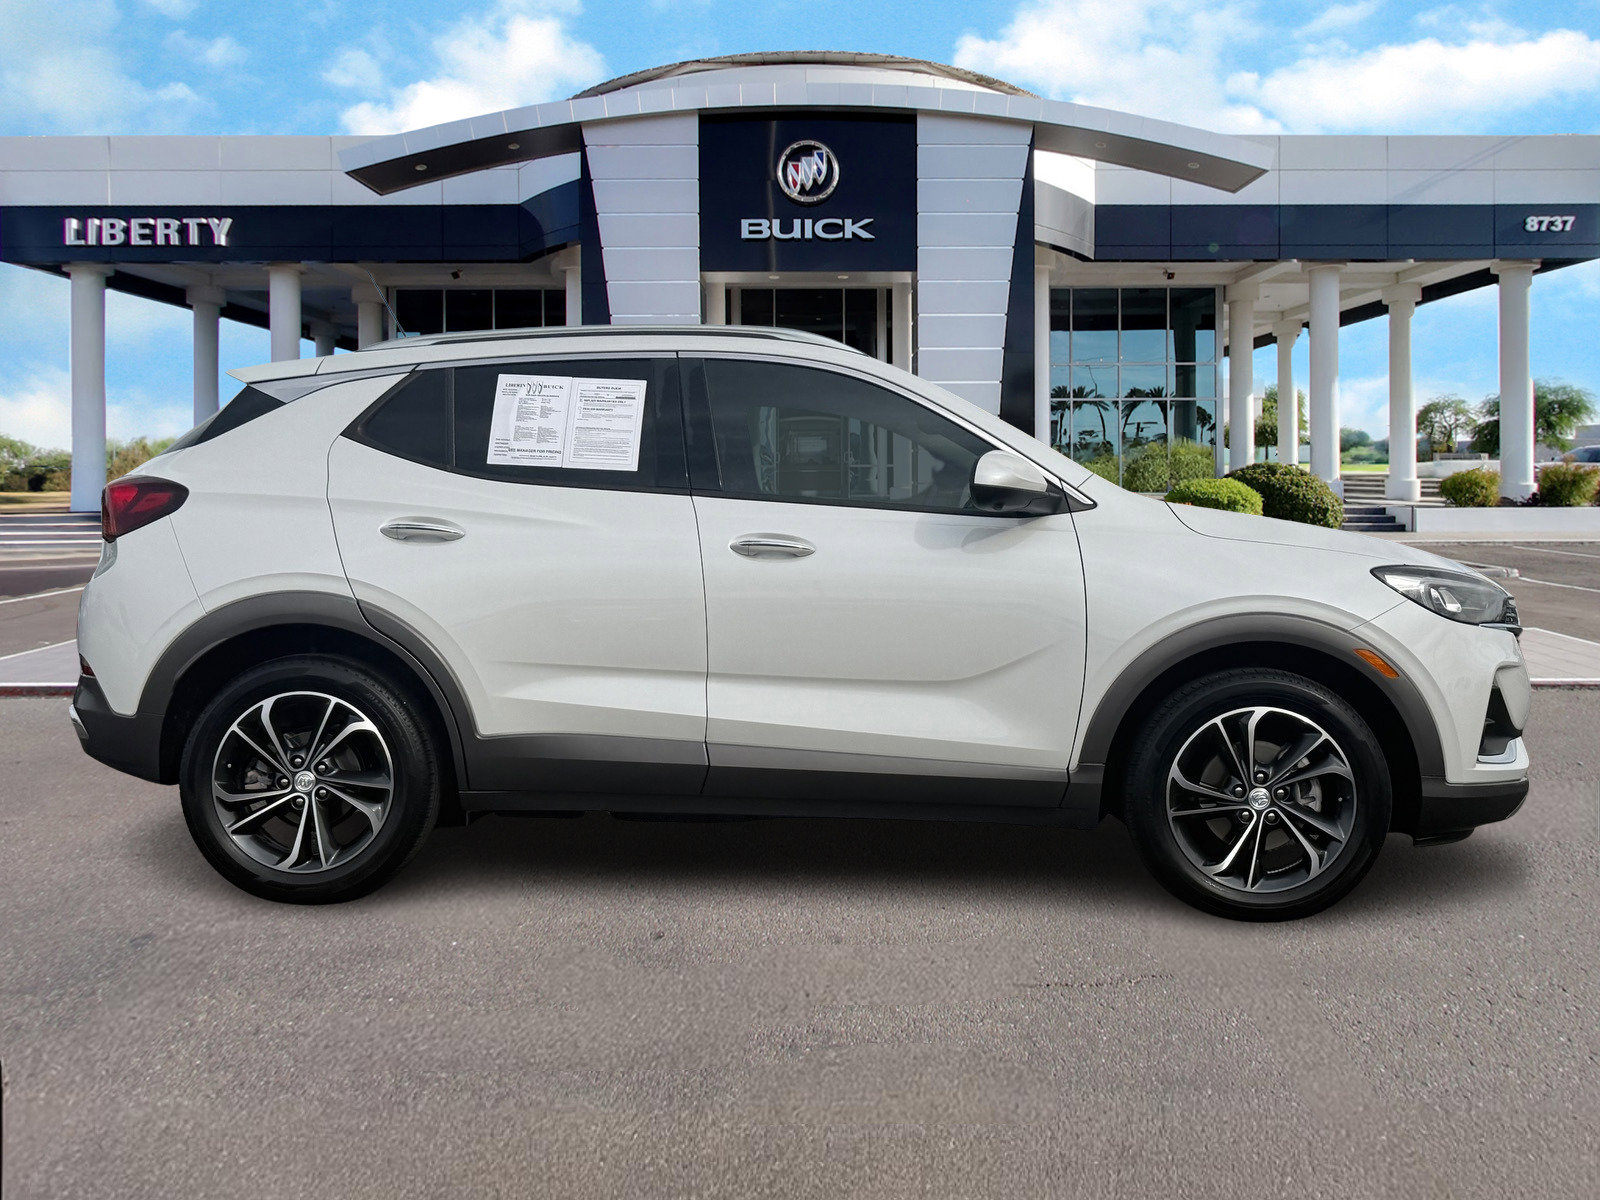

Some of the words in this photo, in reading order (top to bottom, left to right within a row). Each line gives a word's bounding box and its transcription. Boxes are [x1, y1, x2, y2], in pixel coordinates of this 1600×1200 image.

[64, 217, 233, 246] LIBERTY
[741, 218, 875, 239] BUICK
[1525, 215, 1576, 232] 8737
